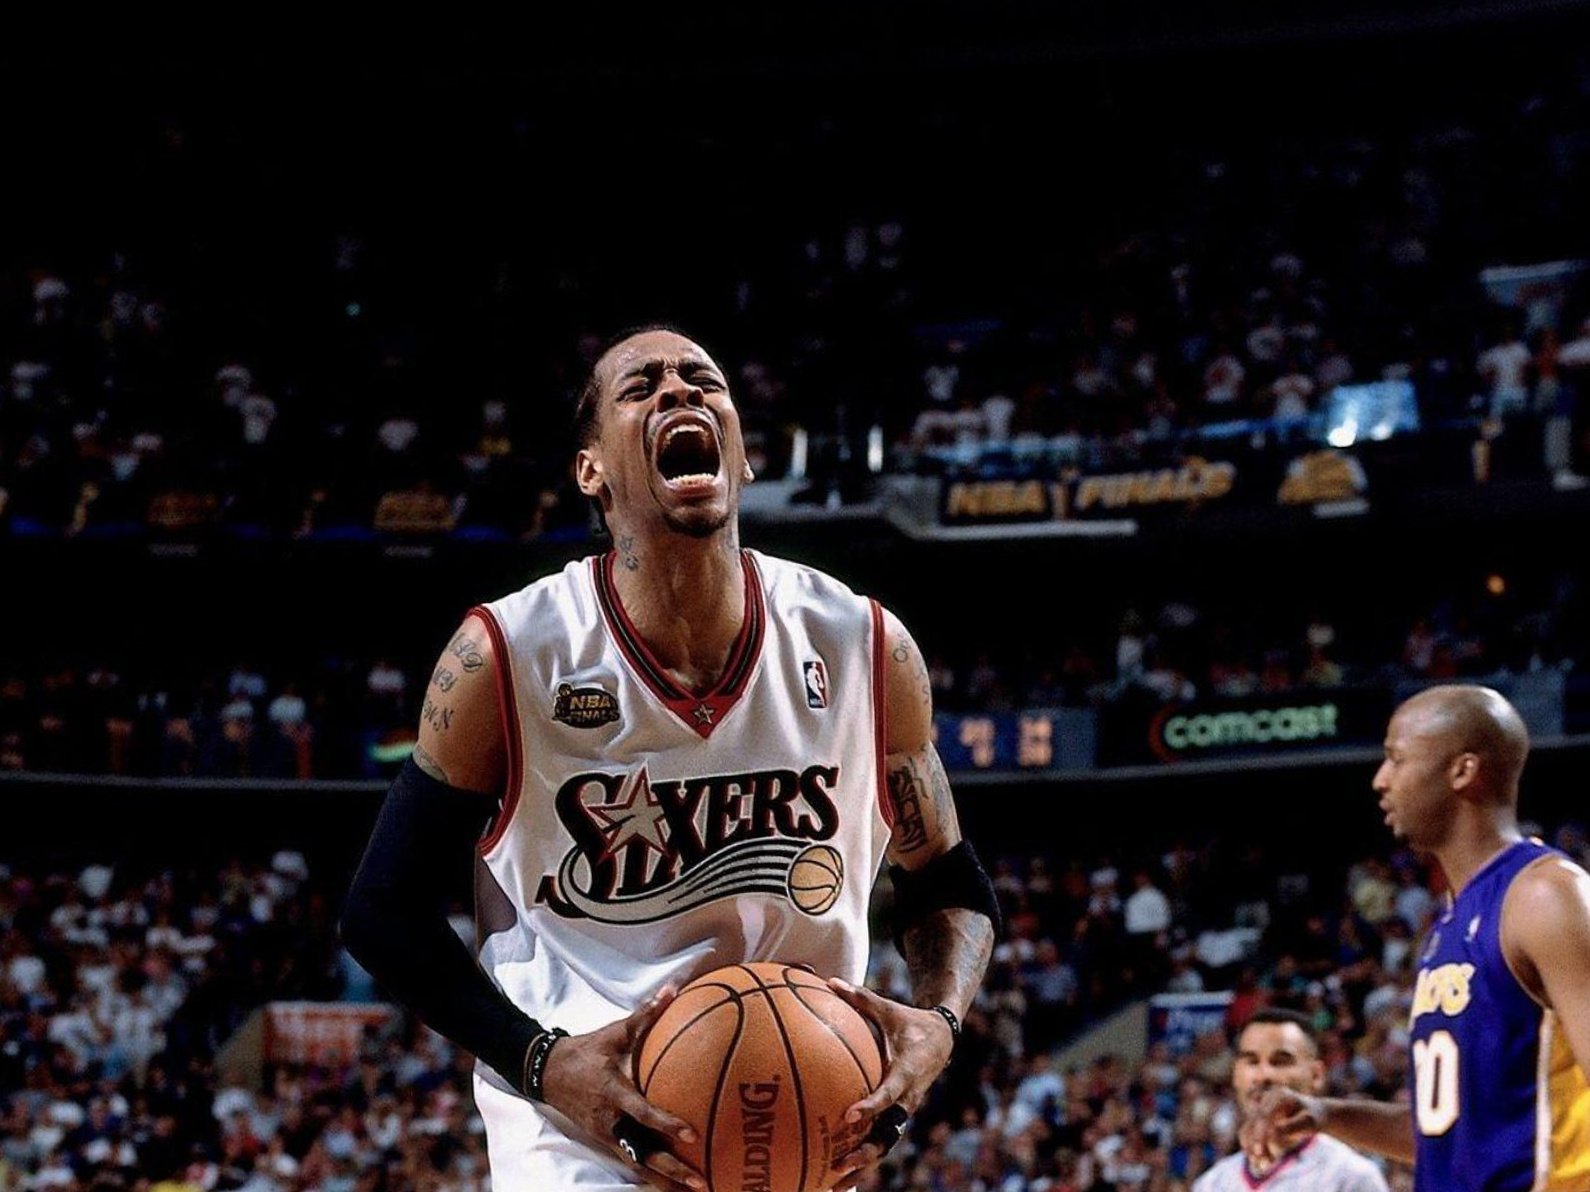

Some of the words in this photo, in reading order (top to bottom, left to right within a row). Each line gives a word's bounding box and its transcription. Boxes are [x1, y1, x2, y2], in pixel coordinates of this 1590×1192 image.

[948, 479, 1048, 515] NBA
[569, 695, 611, 710] NBA
[1164, 703, 1338, 748] comcast
